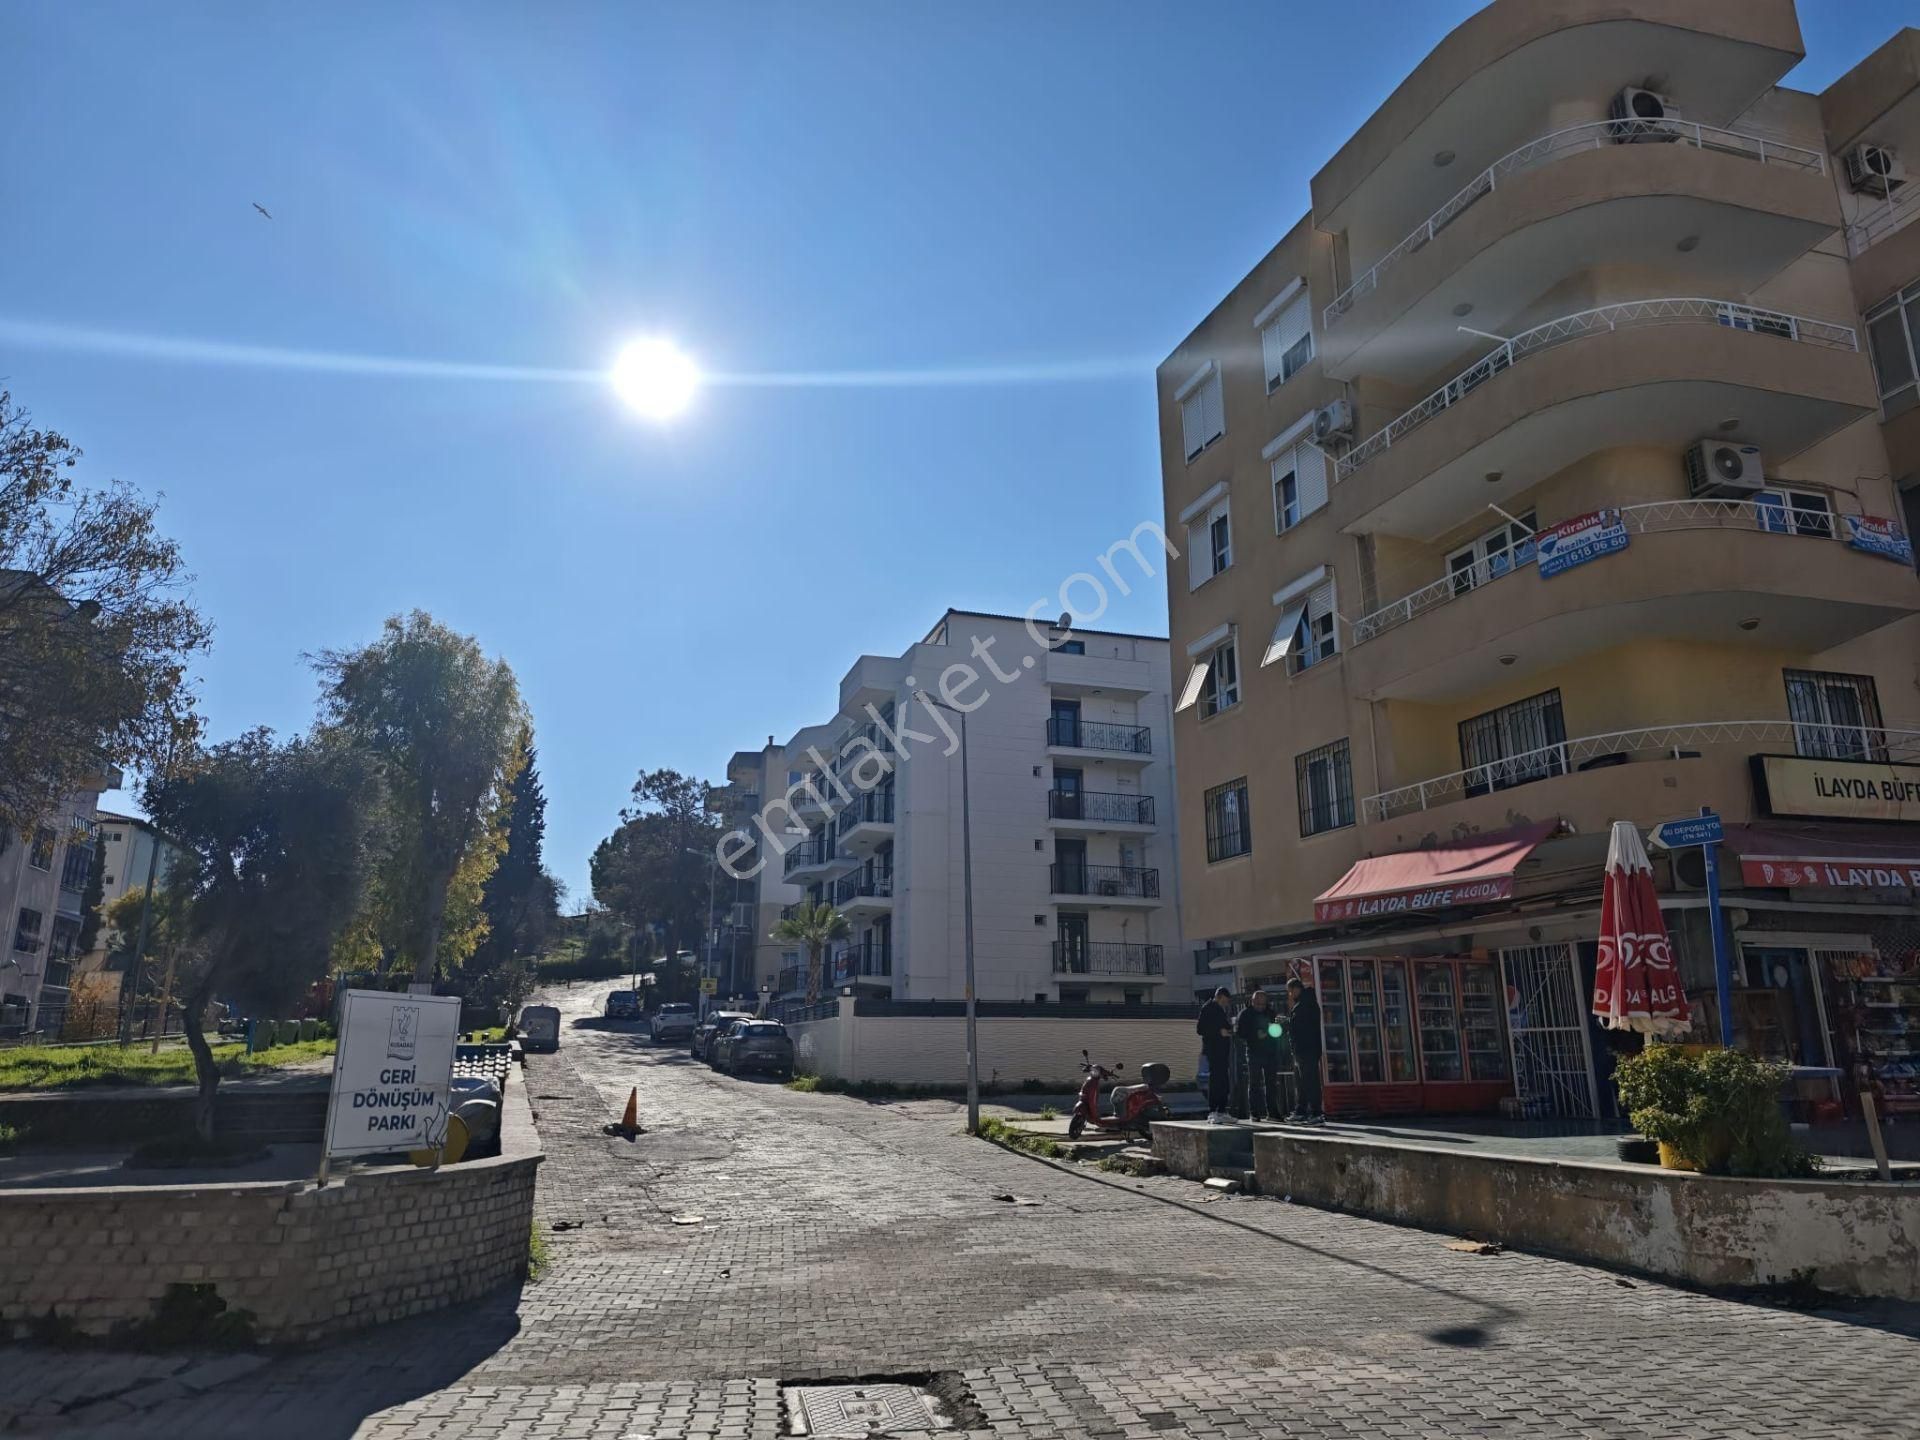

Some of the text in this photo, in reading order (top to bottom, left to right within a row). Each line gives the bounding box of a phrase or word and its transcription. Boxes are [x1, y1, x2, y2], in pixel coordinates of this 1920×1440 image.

[1814, 772, 1879, 800] İLAYDA
[1674, 824, 1705, 835] DEPOSU
[1824, 863, 1906, 887] İLAYDA
[1357, 896, 1407, 915] İLAYDA
[1411, 889, 1454, 908] BÜFE
[380, 1065, 416, 1085] GERİ
[353, 1088, 435, 1111] DÖNÜŞÜM
[367, 1115, 416, 1131] PARKI
